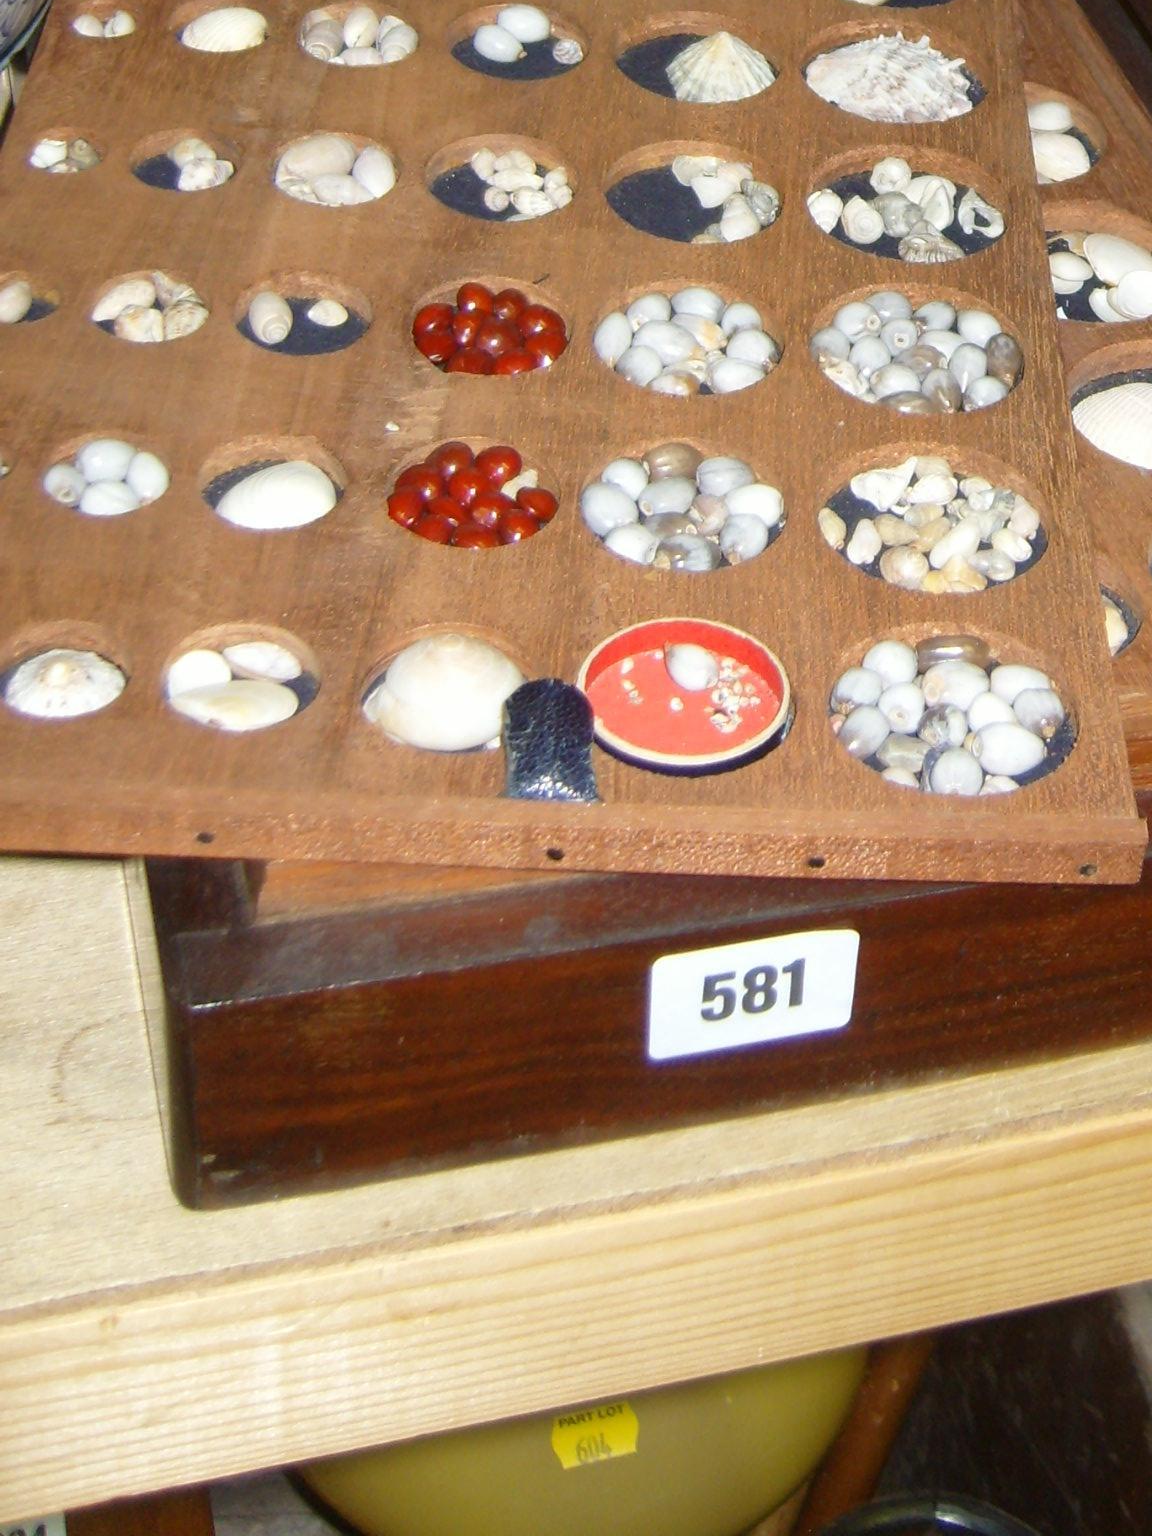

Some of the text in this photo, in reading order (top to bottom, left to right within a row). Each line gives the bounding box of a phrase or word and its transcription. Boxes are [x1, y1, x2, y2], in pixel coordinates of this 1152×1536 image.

[700, 957, 806, 1022] 581
[558, 1404, 625, 1428] PART LOT
